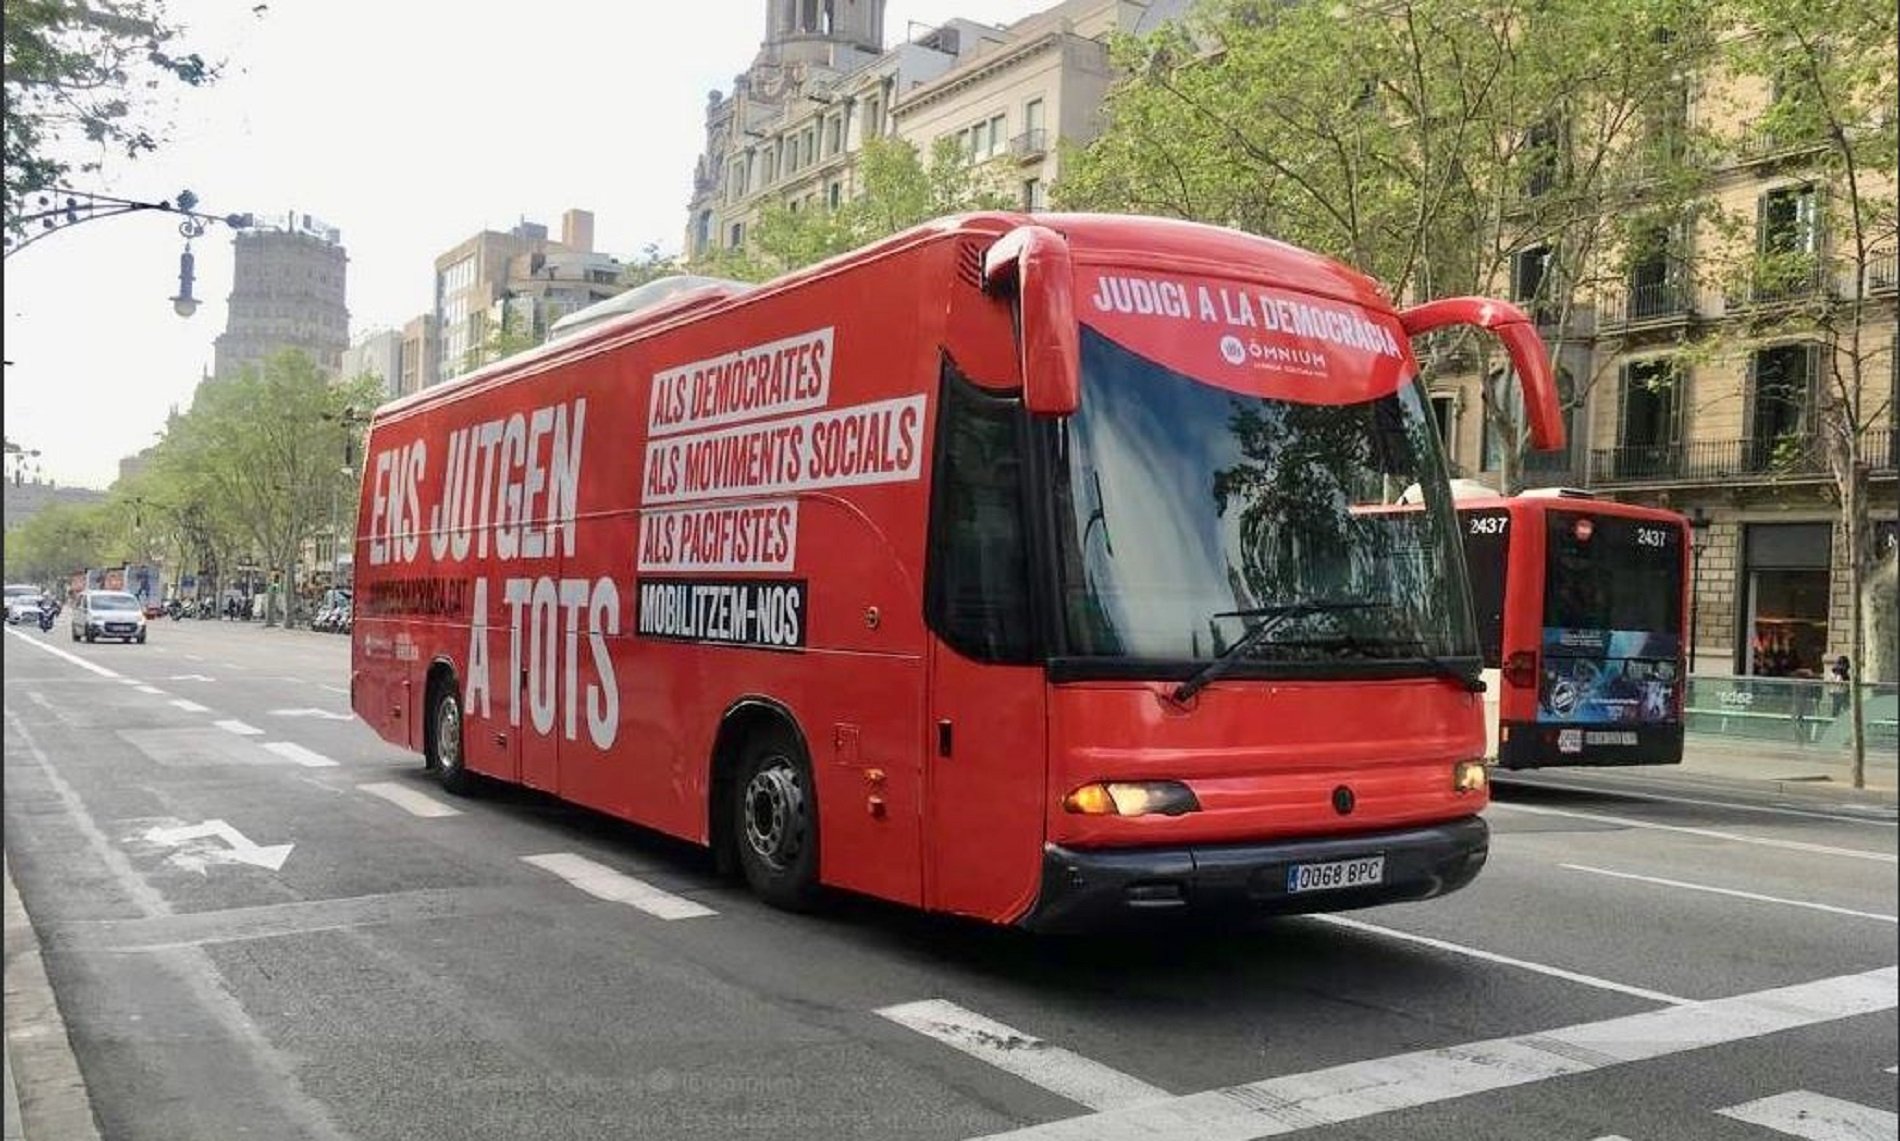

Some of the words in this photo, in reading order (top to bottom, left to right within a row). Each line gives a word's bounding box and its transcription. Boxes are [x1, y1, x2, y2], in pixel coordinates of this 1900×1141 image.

[1092, 276, 1191, 319] JUDICI
[1198, 286, 1217, 322] A
[1220, 287, 1257, 327] LA
[1259, 296, 1402, 360] DEMOCRÀCIA
[653, 374, 686, 428] ALS
[689, 339, 824, 420] DEMÒCRATES
[1248, 338, 1326, 368] ÒMNIUM
[647, 445, 680, 496] ALS
[684, 425, 803, 492] MOVIMENTS
[809, 406, 916, 479] SOCIALS
[370, 438, 427, 566] ENS
[430, 398, 586, 563] JUTGEN
[643, 515, 675, 564] ALS
[679, 506, 791, 564] PACIFISTES
[1469, 517, 1508, 535] 2437
[1638, 528, 1666, 547] 2437
[640, 584, 800, 645] MOBILITZEM-NOS
[464, 577, 491, 719] A
[503, 576, 619, 750] TOTS
[1300, 864, 1343, 888] 0068
[1347, 861, 1379, 883] BPC
